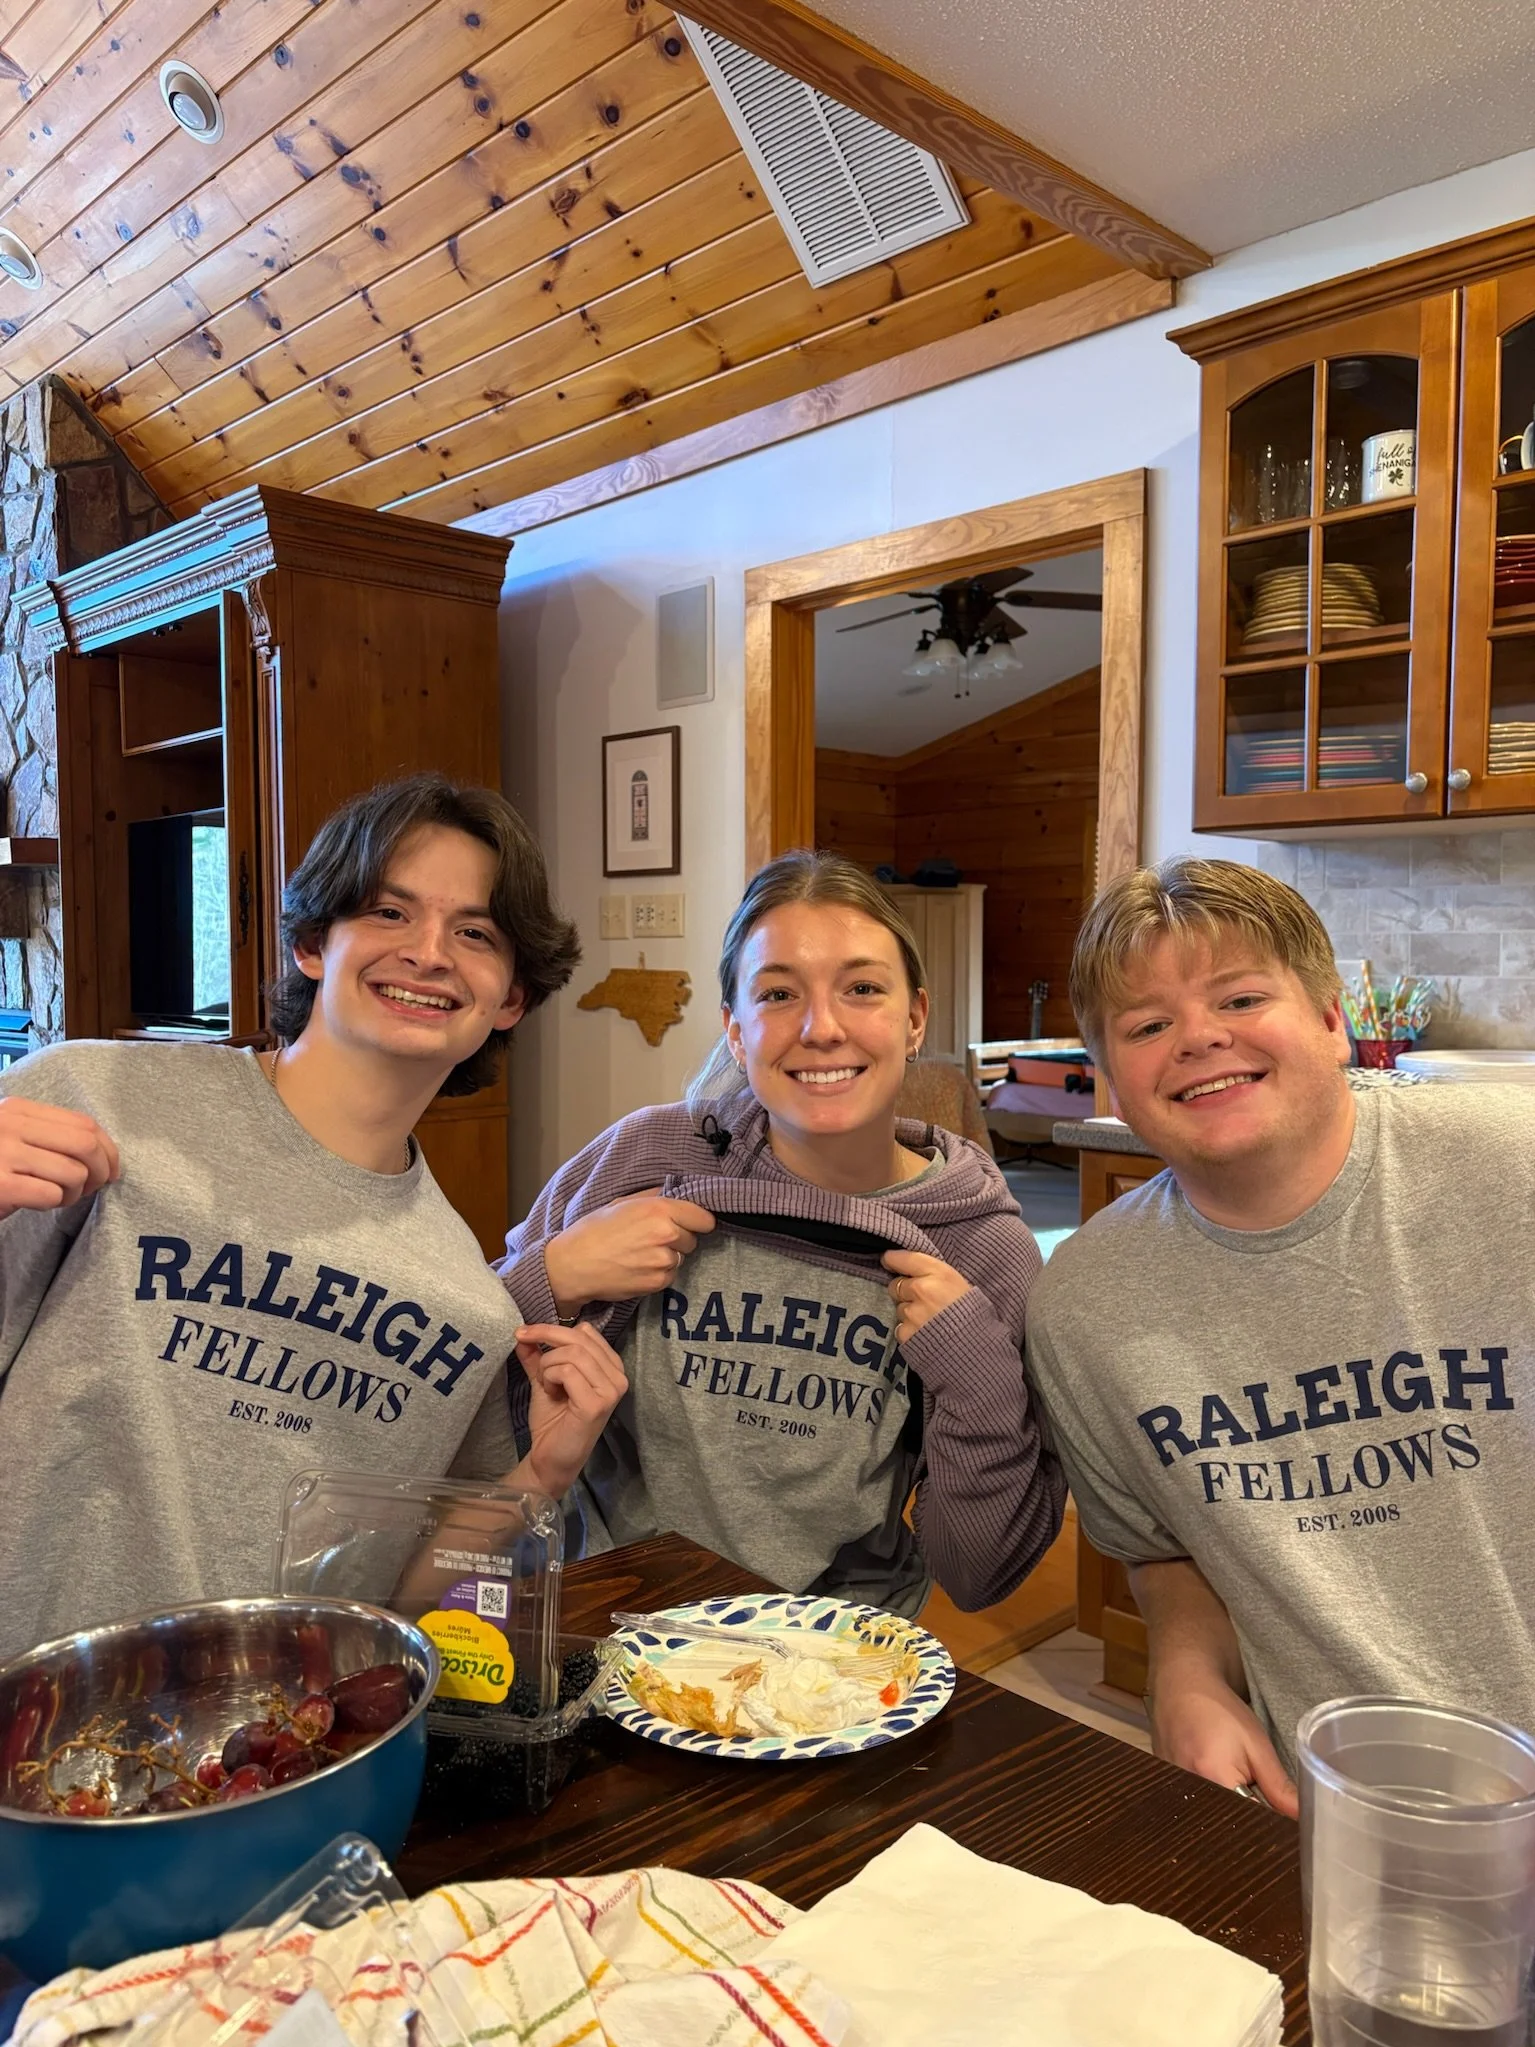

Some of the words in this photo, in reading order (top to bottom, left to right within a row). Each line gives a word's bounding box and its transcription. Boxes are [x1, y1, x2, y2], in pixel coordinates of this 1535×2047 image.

[135, 1235, 485, 1397] RALEIGH
[157, 1314, 412, 1424] FELLOWS
[675, 1350, 886, 1426] FELLOWS
[227, 1399, 268, 1426] EST.
[274, 1410, 313, 1434] 2008
[736, 1409, 774, 1430] EST.
[779, 1418, 818, 1439] 2008
[1137, 1347, 1515, 1467] RALEIGH
[1195, 1423, 1481, 1504] FELLOWS
[1297, 1512, 1346, 1533] EST.
[1351, 1503, 1401, 1528] 2008
[431, 1629, 480, 1645] Blackberries
[467, 1651, 479, 1659] the
[479, 1652, 495, 1662] Only
